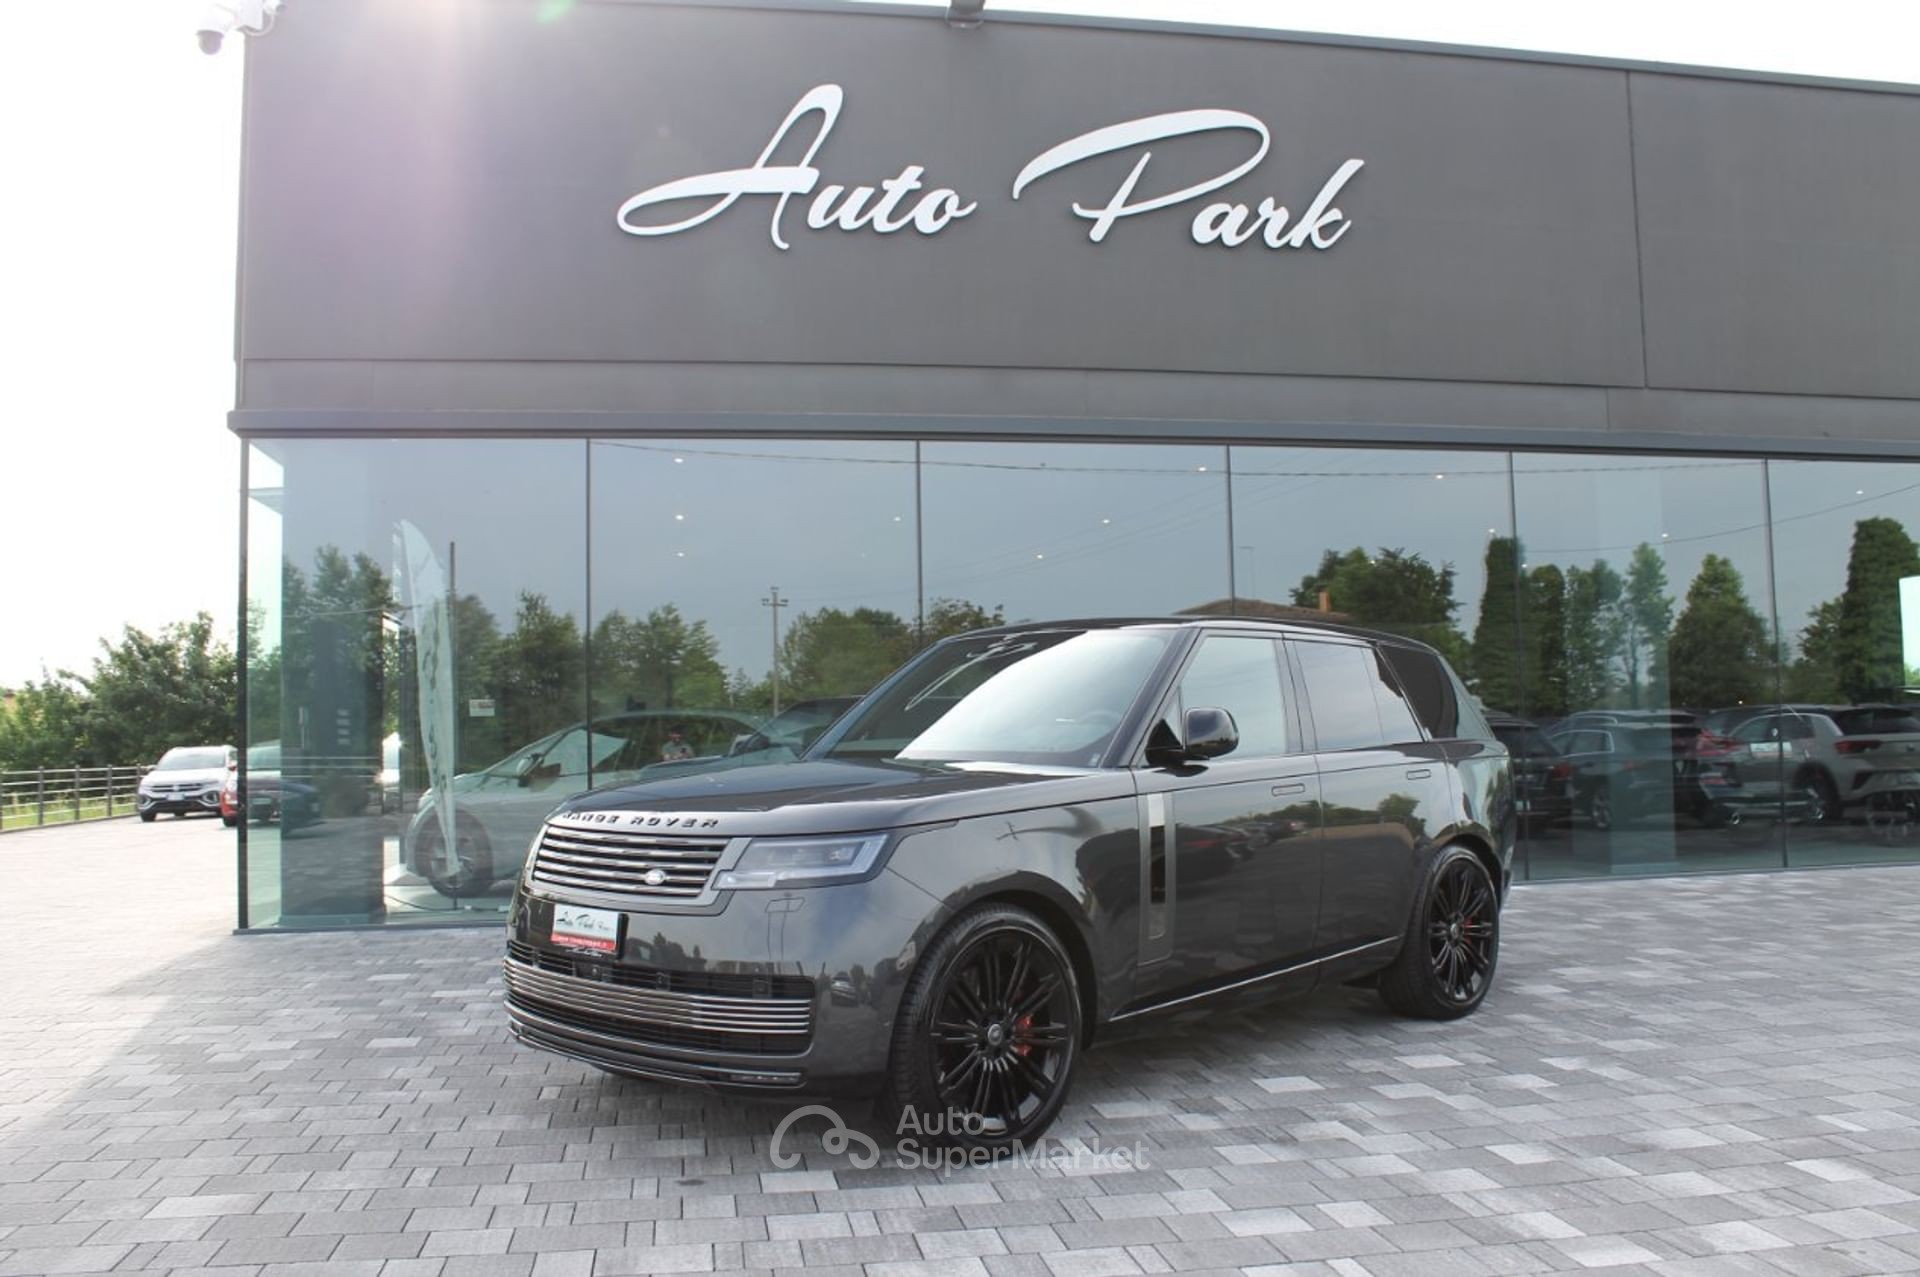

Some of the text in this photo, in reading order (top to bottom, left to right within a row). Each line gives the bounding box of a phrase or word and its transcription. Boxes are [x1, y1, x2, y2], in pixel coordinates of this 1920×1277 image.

[616, 83, 1365, 250] Auto Park
[630, 816, 720, 828] ROVER
